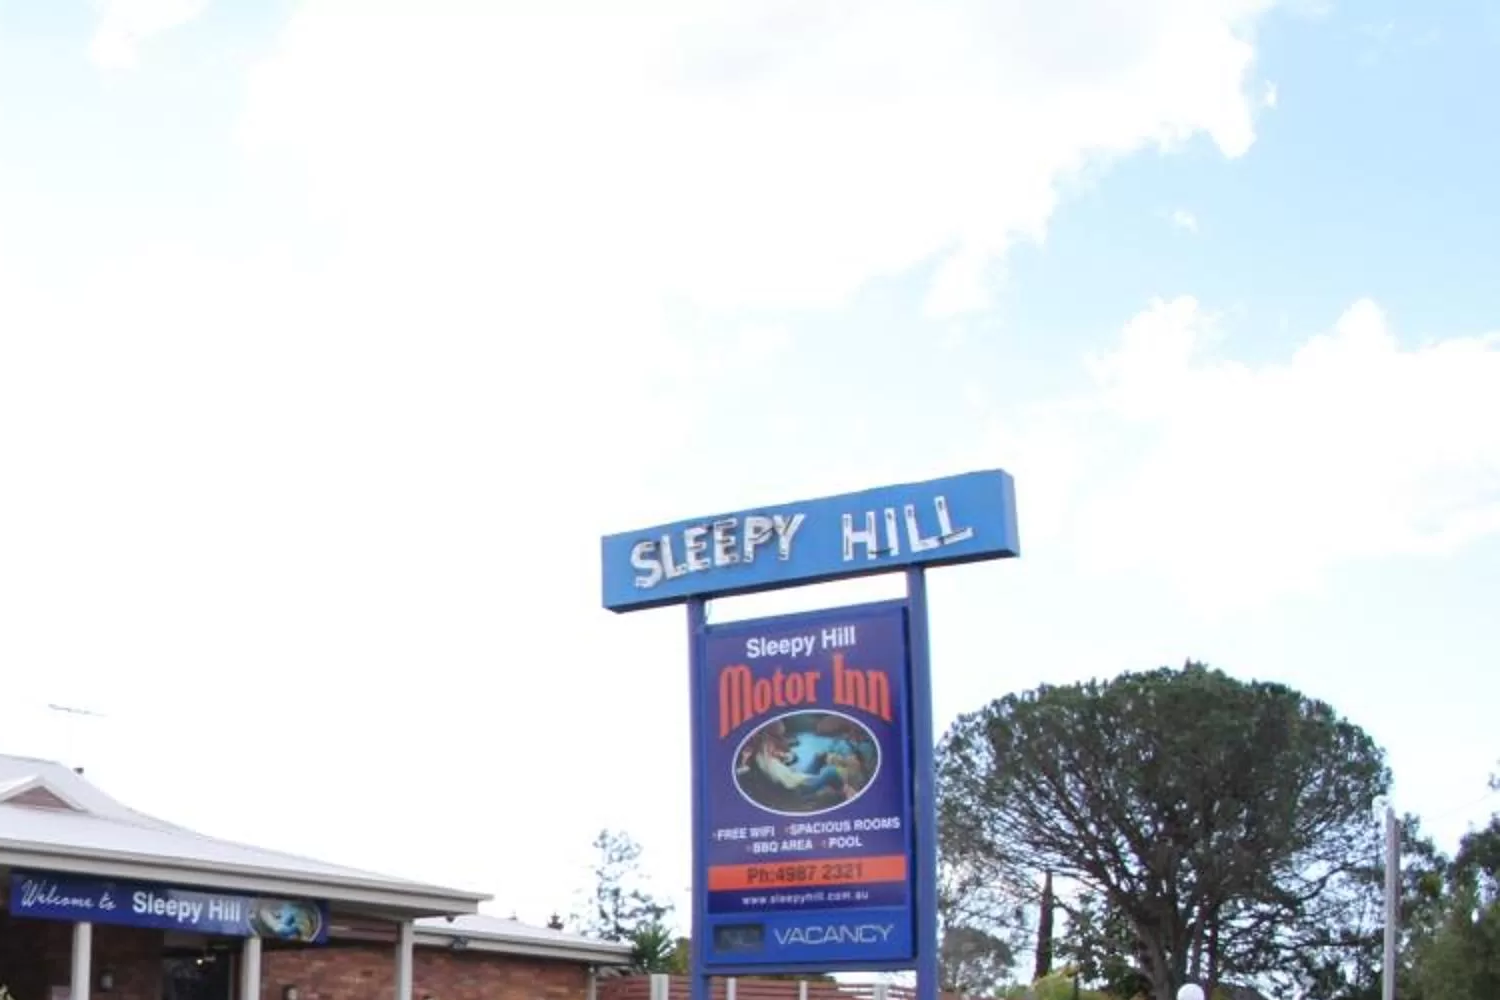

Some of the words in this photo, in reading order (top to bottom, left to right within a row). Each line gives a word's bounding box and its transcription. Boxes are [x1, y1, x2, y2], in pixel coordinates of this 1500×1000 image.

[630, 513, 806, 589] SLEEPY
[841, 495, 975, 563] HILL
[745, 631, 816, 659] Sleepy
[822, 625, 857, 650] Hill
[718, 663, 821, 739] Motor
[832, 651, 893, 722] Inn
[716, 828, 747, 841] FREE
[749, 825, 776, 839] WIFI
[788, 819, 851, 836] SPACIOUS
[853, 816, 901, 831] ROOMS
[752, 840, 779, 854] BBQ
[780, 840, 813, 852] AREA
[828, 836, 864, 849] POOL
[21, 879, 93, 908] Welcome
[97, 892, 117, 912] to
[132, 890, 203, 924] Sleepy
[208, 899, 241, 922] Hill
[773, 923, 895, 945] VACANCY
